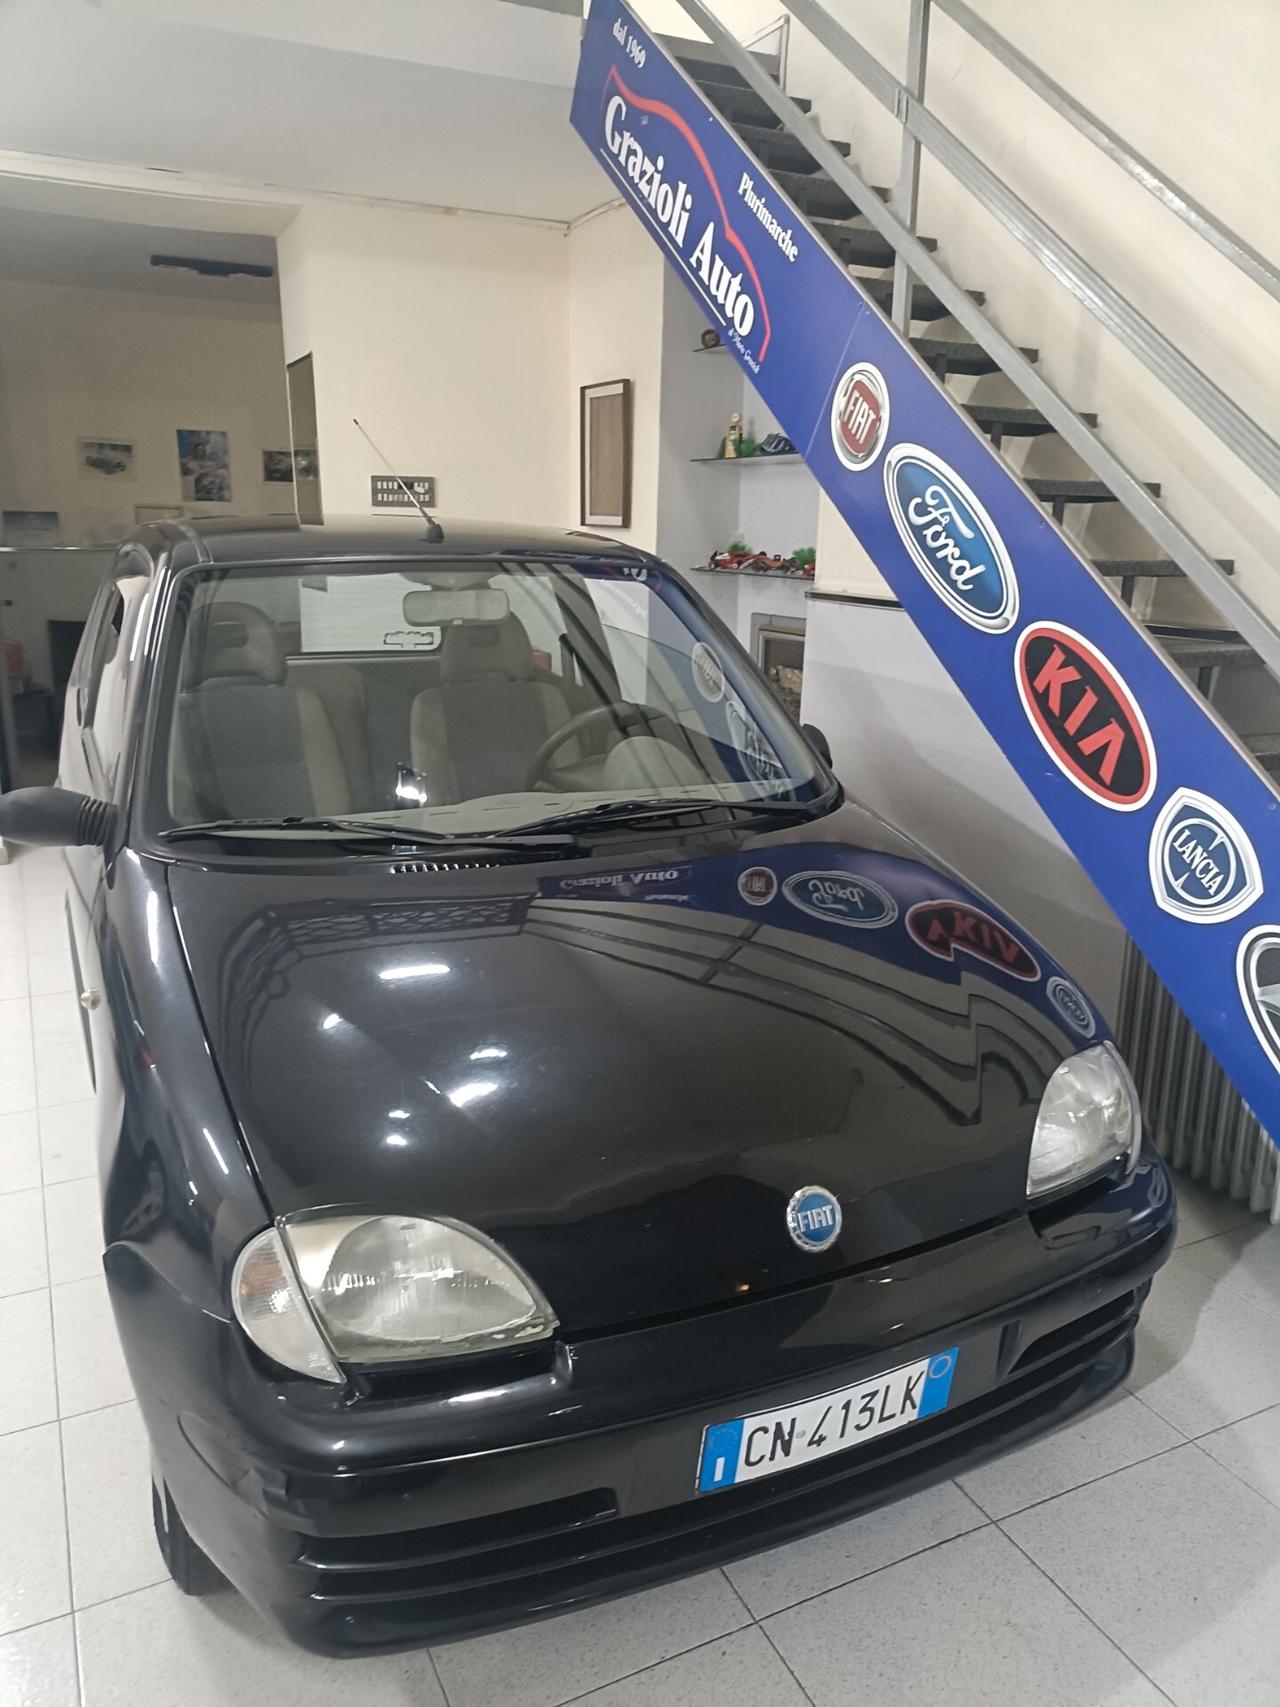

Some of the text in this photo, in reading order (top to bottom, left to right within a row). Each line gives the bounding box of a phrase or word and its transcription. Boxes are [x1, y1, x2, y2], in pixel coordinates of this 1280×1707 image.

[612, 18, 646, 69] dal 1969
[604, 95, 692, 248] Grazioli
[689, 221, 755, 336] Auto
[737, 172, 799, 262] Plurimarche
[842, 389, 877, 444] FIAT
[907, 485, 987, 591] Ford
[1032, 643, 1126, 786] KIA
[1172, 828, 1225, 896] LANCIA
[797, 1205, 834, 1232] FIAT
[713, 1457, 725, 1482] I
